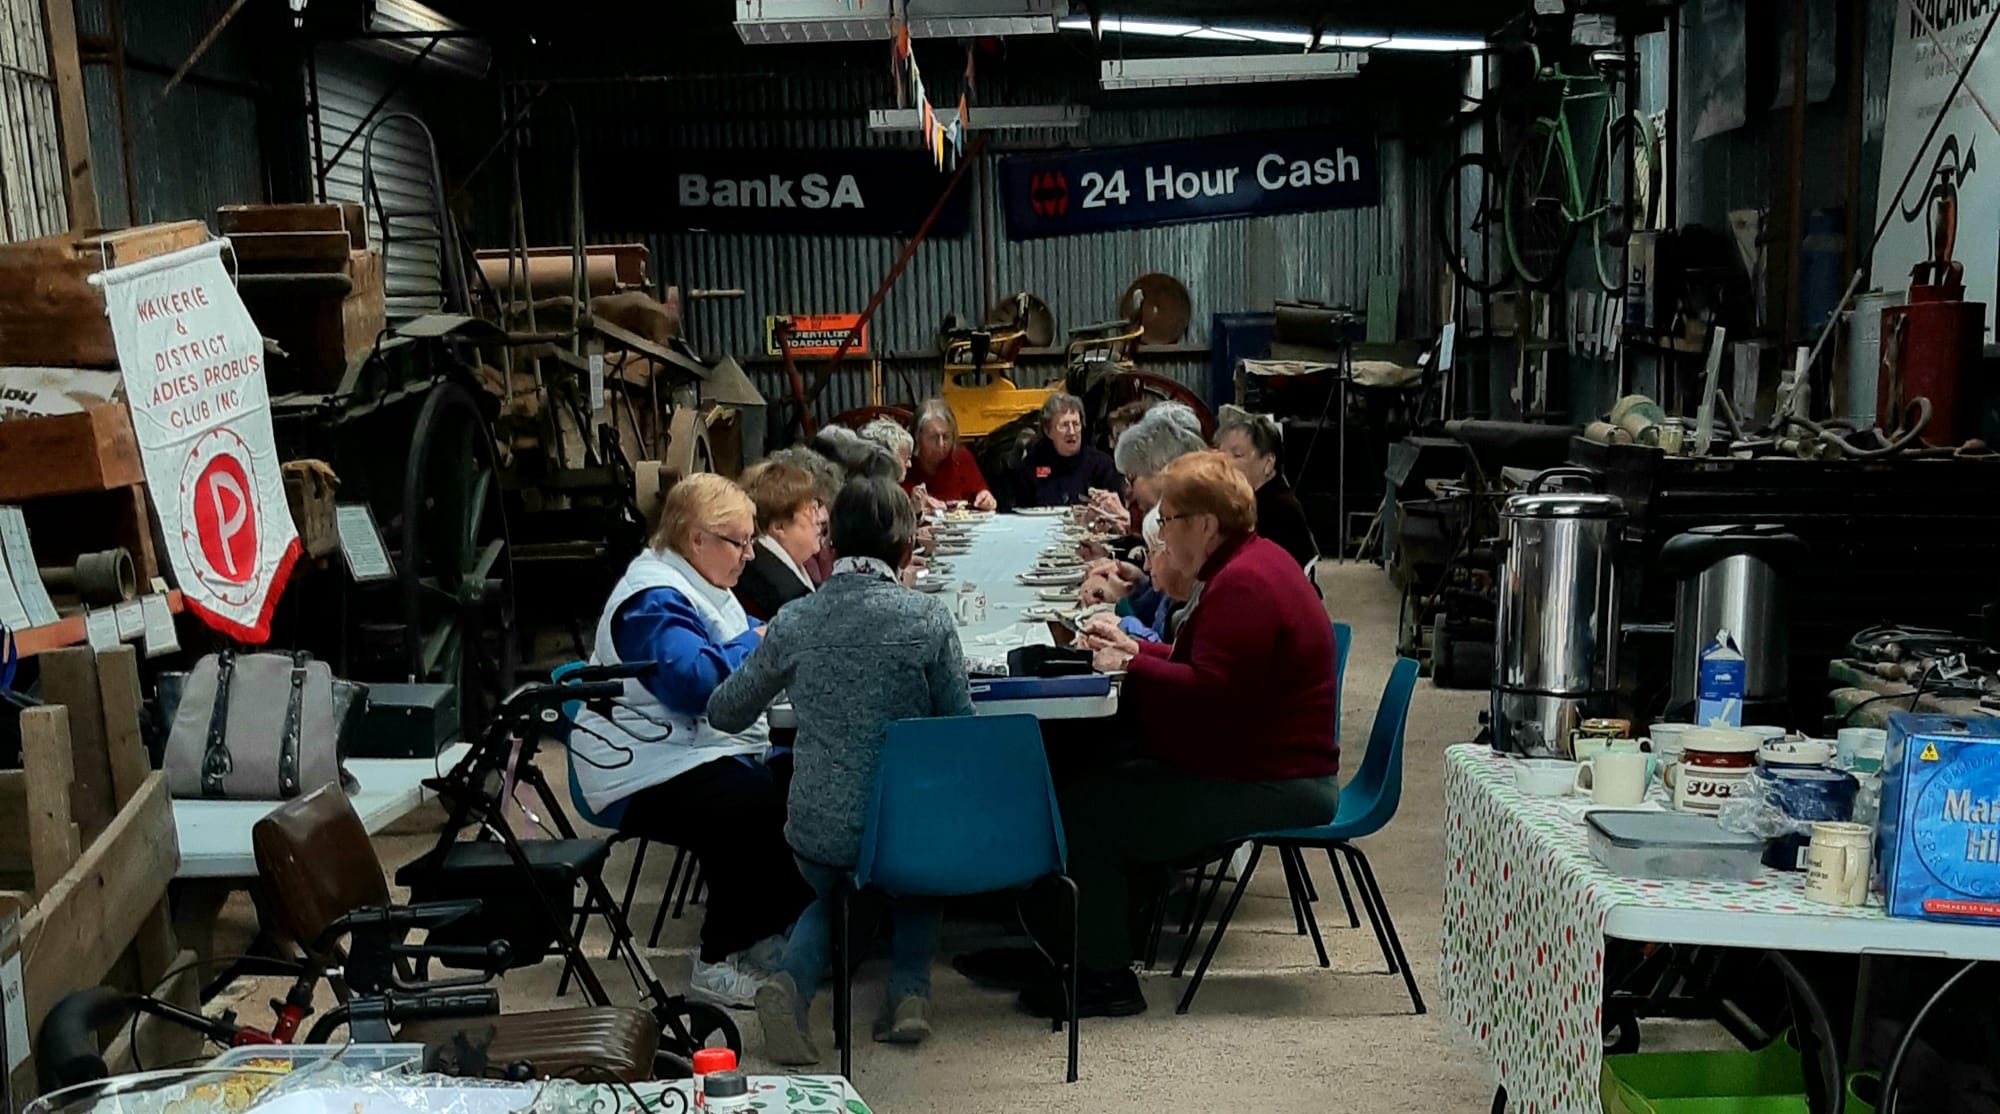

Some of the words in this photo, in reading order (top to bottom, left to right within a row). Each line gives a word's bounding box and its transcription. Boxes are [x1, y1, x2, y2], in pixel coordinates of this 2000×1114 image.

[678, 173, 865, 208] BankSA
[1080, 169, 1130, 208] 24
[1145, 164, 1240, 202] Hour
[1256, 147, 1360, 190] Cash
[137, 286, 209, 322] WAIKERIE
[176, 318, 188, 335] &
[795, 330, 853, 339] FERTILIZE
[155, 335, 228, 372] DISTRICT
[147, 374, 199, 408] ADIES
[204, 355, 260, 387] PROBUS
[170, 400, 210, 428] CLUB
[209, 470, 247, 575] P
[1687, 780, 1741, 798] SUG
[1964, 828, 2000, 863] Hi
